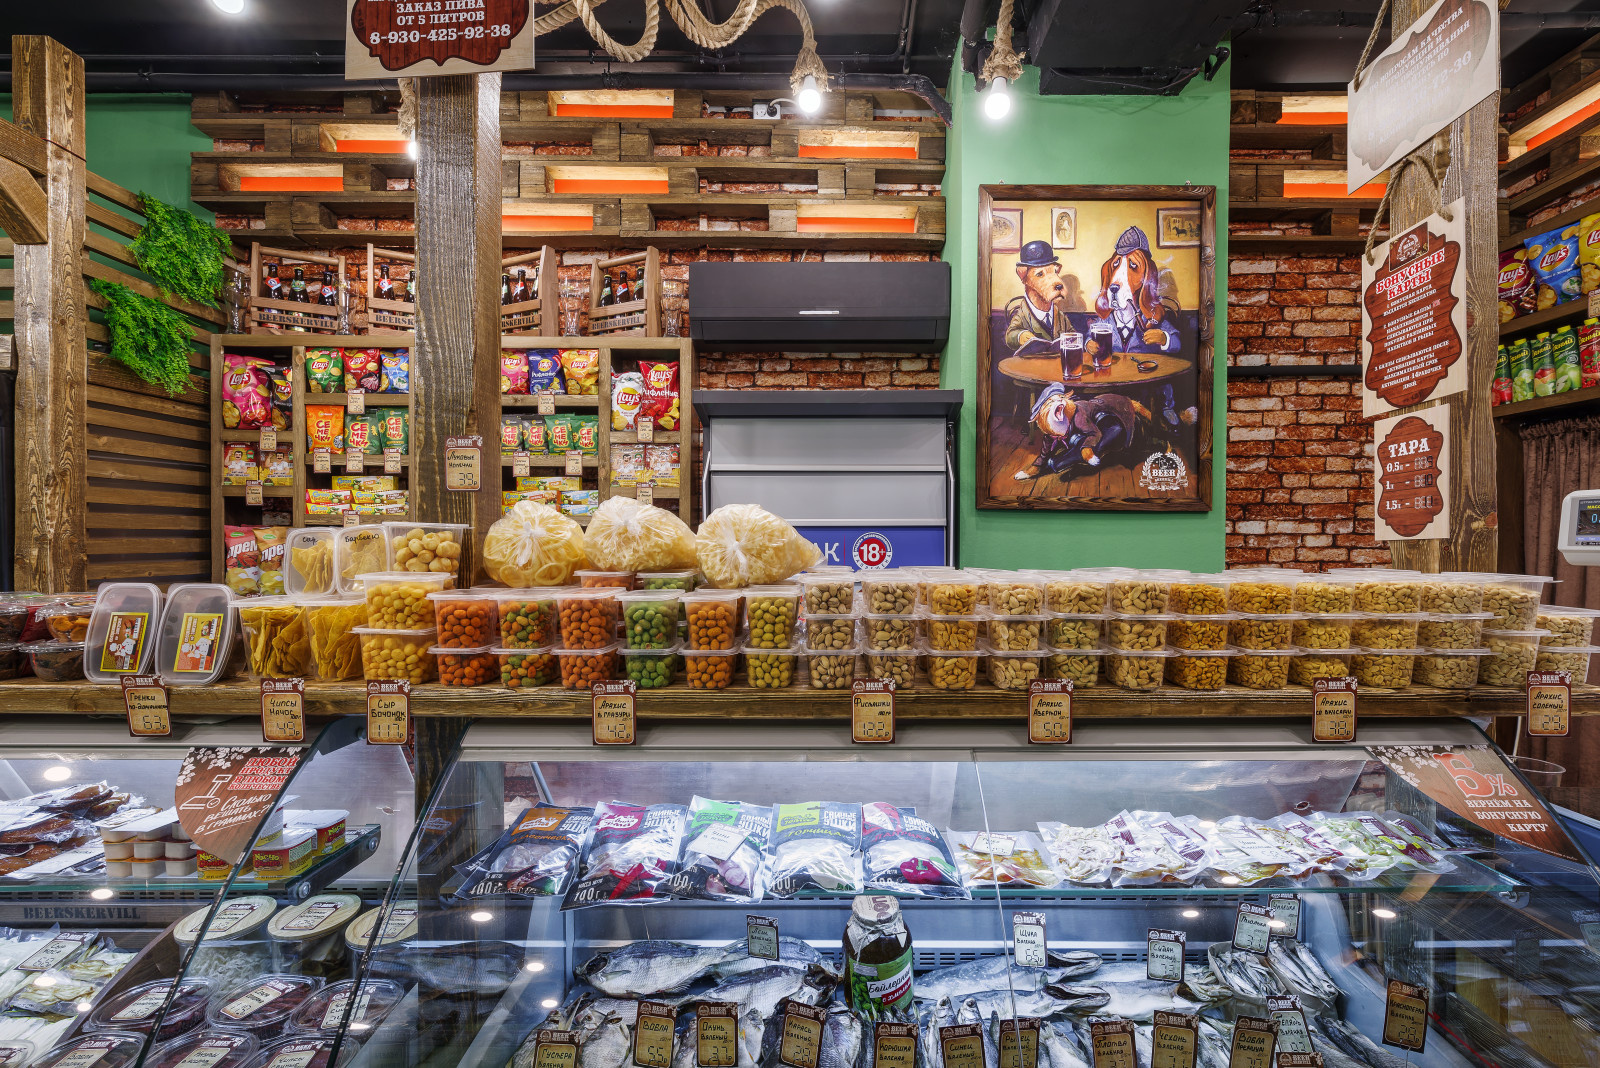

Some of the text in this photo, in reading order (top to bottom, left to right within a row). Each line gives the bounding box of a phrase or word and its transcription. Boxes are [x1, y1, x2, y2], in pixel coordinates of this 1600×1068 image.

[396, 0, 486, 14] ЗАКАЗ ПИВА
[396, 11, 485, 26] ОТ 5 ЛИТРОВ
[370, 24, 512, 45] 8-930-425-92-38
[1421, 6, 1463, 49] КАЧЕСТВА
[1541, 245, 1570, 267] Lay's
[1376, 248, 1445, 294] БОНУСНЫЕ
[1387, 269, 1432, 300] КАРТЫ
[258, 312, 336, 329] BEERSKERVILL
[591, 316, 642, 331] BEERSKERVILL
[1388, 438, 1431, 459] ТАРА
[1152, 469, 1176, 477] BEER
[860, 543, 886, 562] 18+
[246, 754, 301, 767] ЛЮБОЙ
[239, 766, 294, 775] ПРОДУКТ
[1432, 751, 1518, 798] 5%
[227, 783, 284, 791] КОЛИЧЕСТВЕ
[232, 775, 288, 784] В ЛЮБОМ
[1464, 799, 1533, 808] ВЕРНЁМ НА
[823, 810, 856, 819] СВИНЫЕ
[1473, 811, 1542, 820] БОНУСНУЮ
[823, 817, 856, 832] УШКИ
[23, 907, 141, 919] BEERSKERVILL
